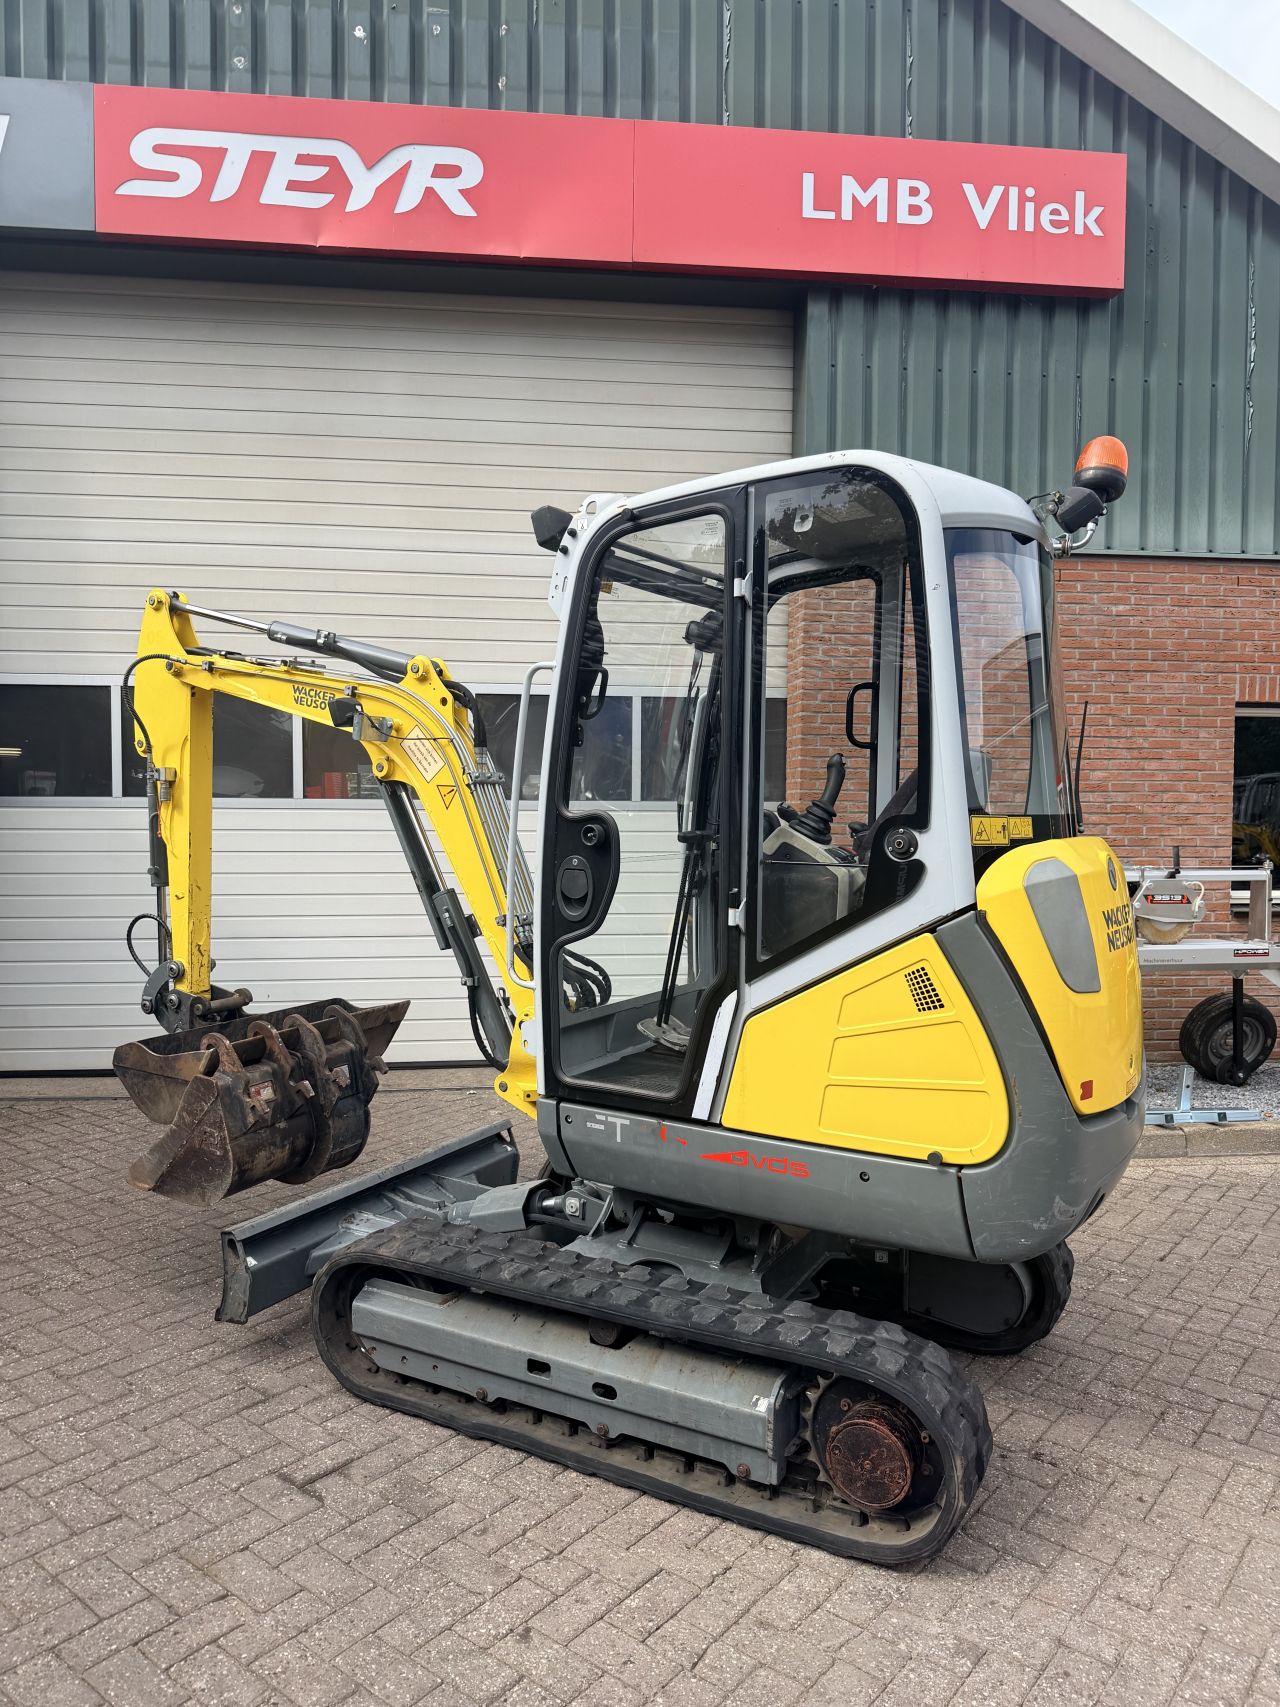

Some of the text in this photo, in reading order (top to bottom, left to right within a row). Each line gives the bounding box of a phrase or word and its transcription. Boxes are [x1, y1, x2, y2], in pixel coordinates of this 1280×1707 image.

[115, 127, 484, 217] STEYR
[802, 172, 1105, 237] LMB Vliek
[293, 695, 327, 711] NEUSO
